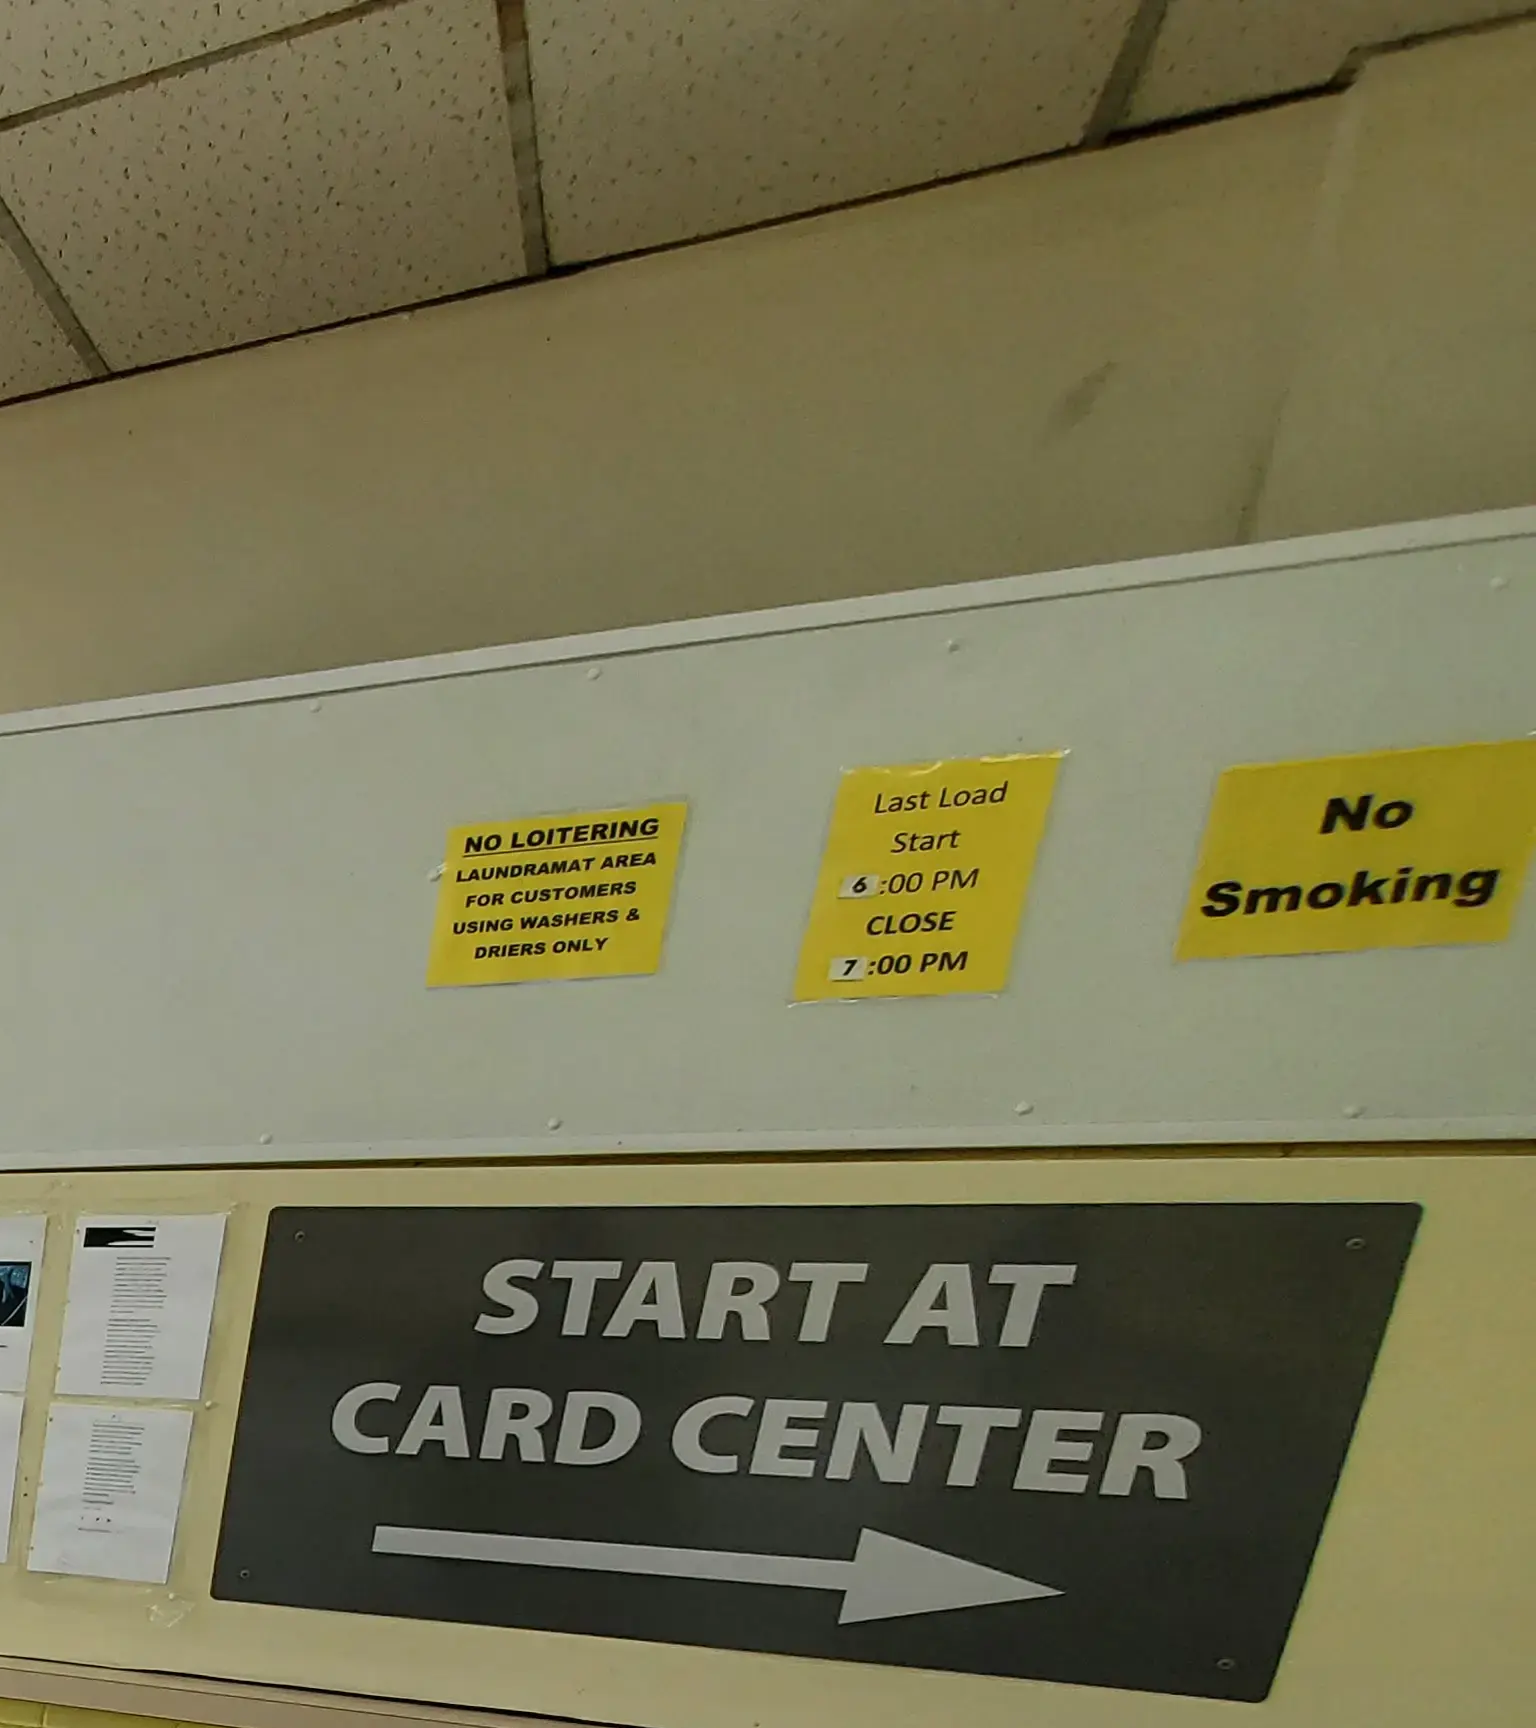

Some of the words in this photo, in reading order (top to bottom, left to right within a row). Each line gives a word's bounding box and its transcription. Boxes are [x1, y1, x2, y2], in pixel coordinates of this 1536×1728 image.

[874, 790, 931, 814] Last
[939, 780, 1009, 808] Load
[1319, 794, 1415, 834] No
[464, 834, 502, 853] NO
[511, 818, 659, 849] LOITERING
[890, 830, 961, 853] Start
[455, 858, 596, 882] LAUNDRAMAT
[600, 852, 656, 869] AREA
[931, 868, 980, 891] PM
[465, 893, 504, 908] FOR
[510, 881, 637, 904] CUSTOMERS
[1200, 867, 1501, 918] Smoking
[453, 918, 513, 935] USING
[520, 910, 619, 930] WASHERS
[625, 908, 640, 921] &
[865, 911, 956, 935] CLOSE
[474, 942, 546, 959] DRIERS
[552, 938, 609, 953] ONLY
[919, 950, 968, 972] PM
[473, 1258, 870, 1342] START
[883, 1263, 1078, 1347] AT
[330, 1382, 642, 1467] CARD
[671, 1395, 1203, 1500] CENTER
